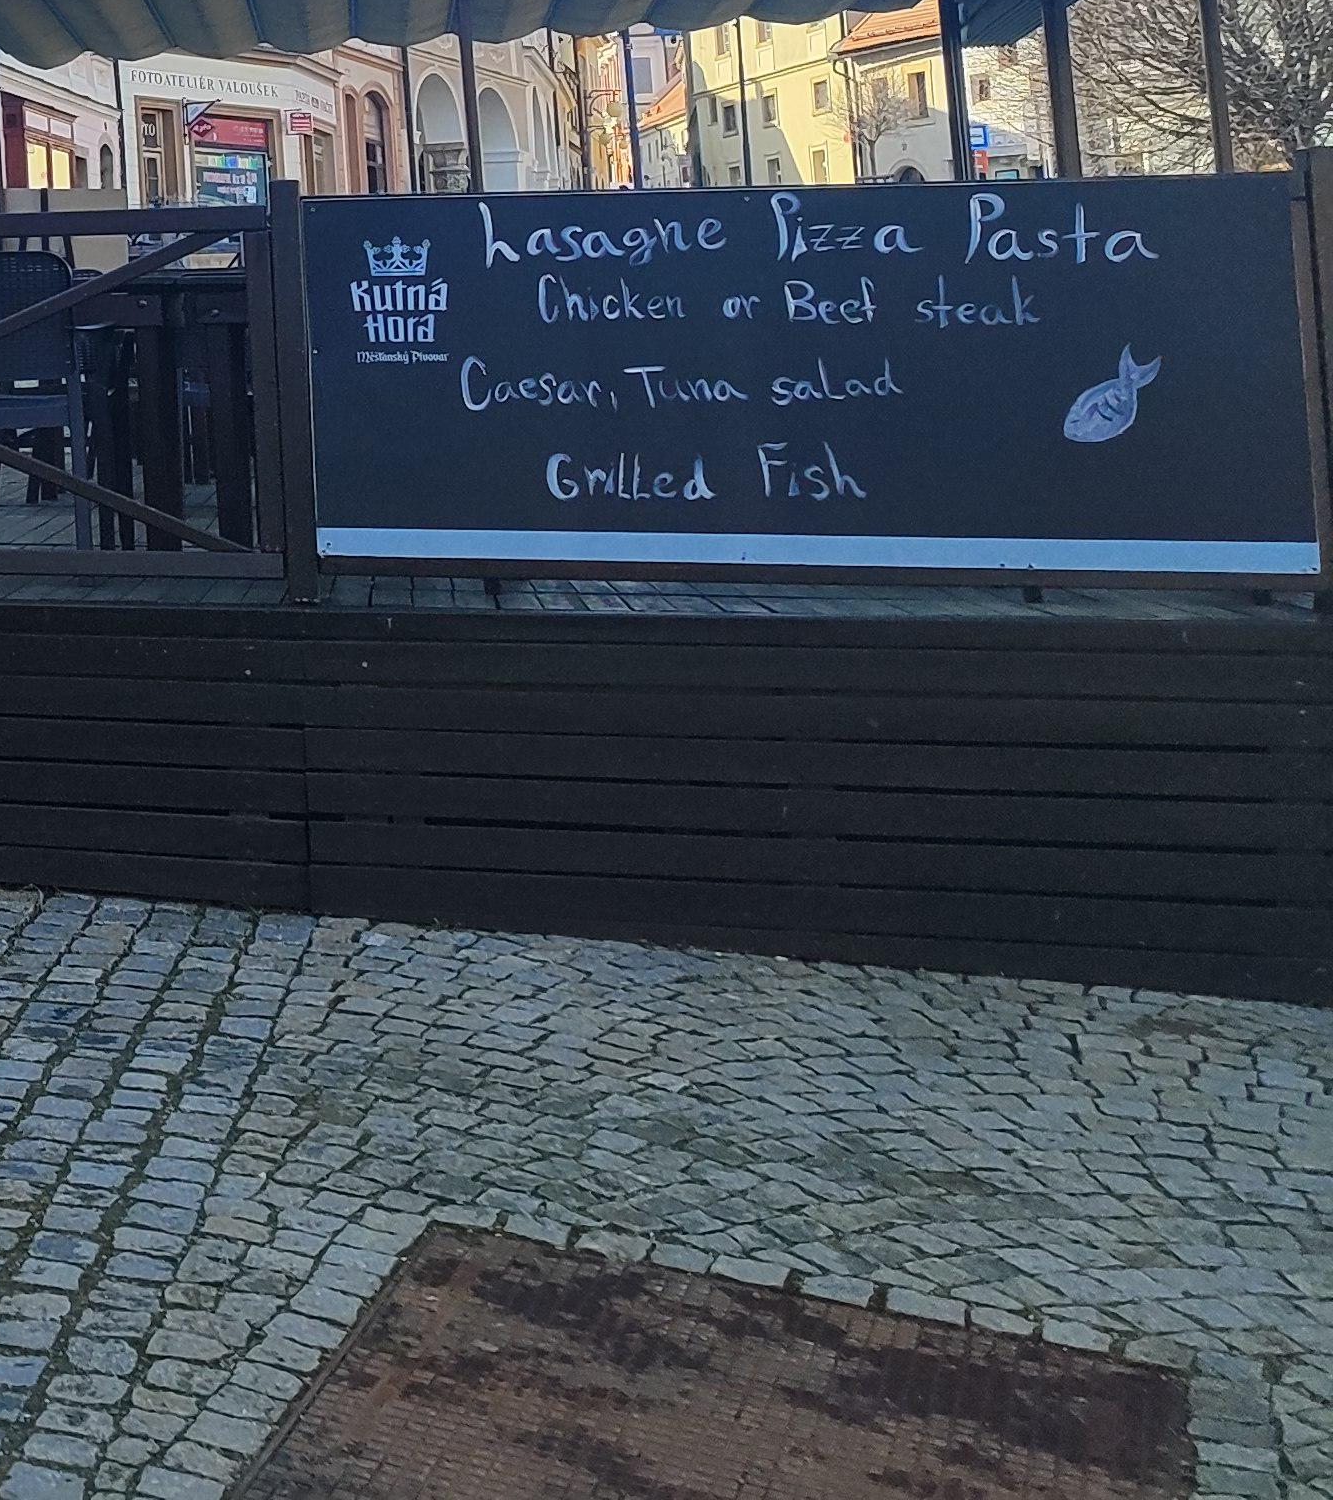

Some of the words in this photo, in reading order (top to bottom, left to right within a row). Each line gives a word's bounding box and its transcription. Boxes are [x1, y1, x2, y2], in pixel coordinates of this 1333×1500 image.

[131, 70, 215, 91] FOTOATELIÉR
[218, 79, 279, 98] VALOUŠEK
[481, 201, 727, 269] Lasagne
[769, 192, 925, 261] Pizza
[964, 192, 1160, 266] Pasta
[350, 277, 449, 312] Kutná
[537, 274, 686, 324] Chicken
[724, 294, 761, 320] or
[785, 277, 876, 324] Beef
[915, 274, 1041, 329] steak
[363, 313, 435, 343] Hora
[459, 355, 618, 411] Caesar,
[624, 365, 749, 402] Tuna
[771, 358, 904, 402] salad
[545, 452, 717, 501] Grilled
[758, 441, 867, 500] Fish
